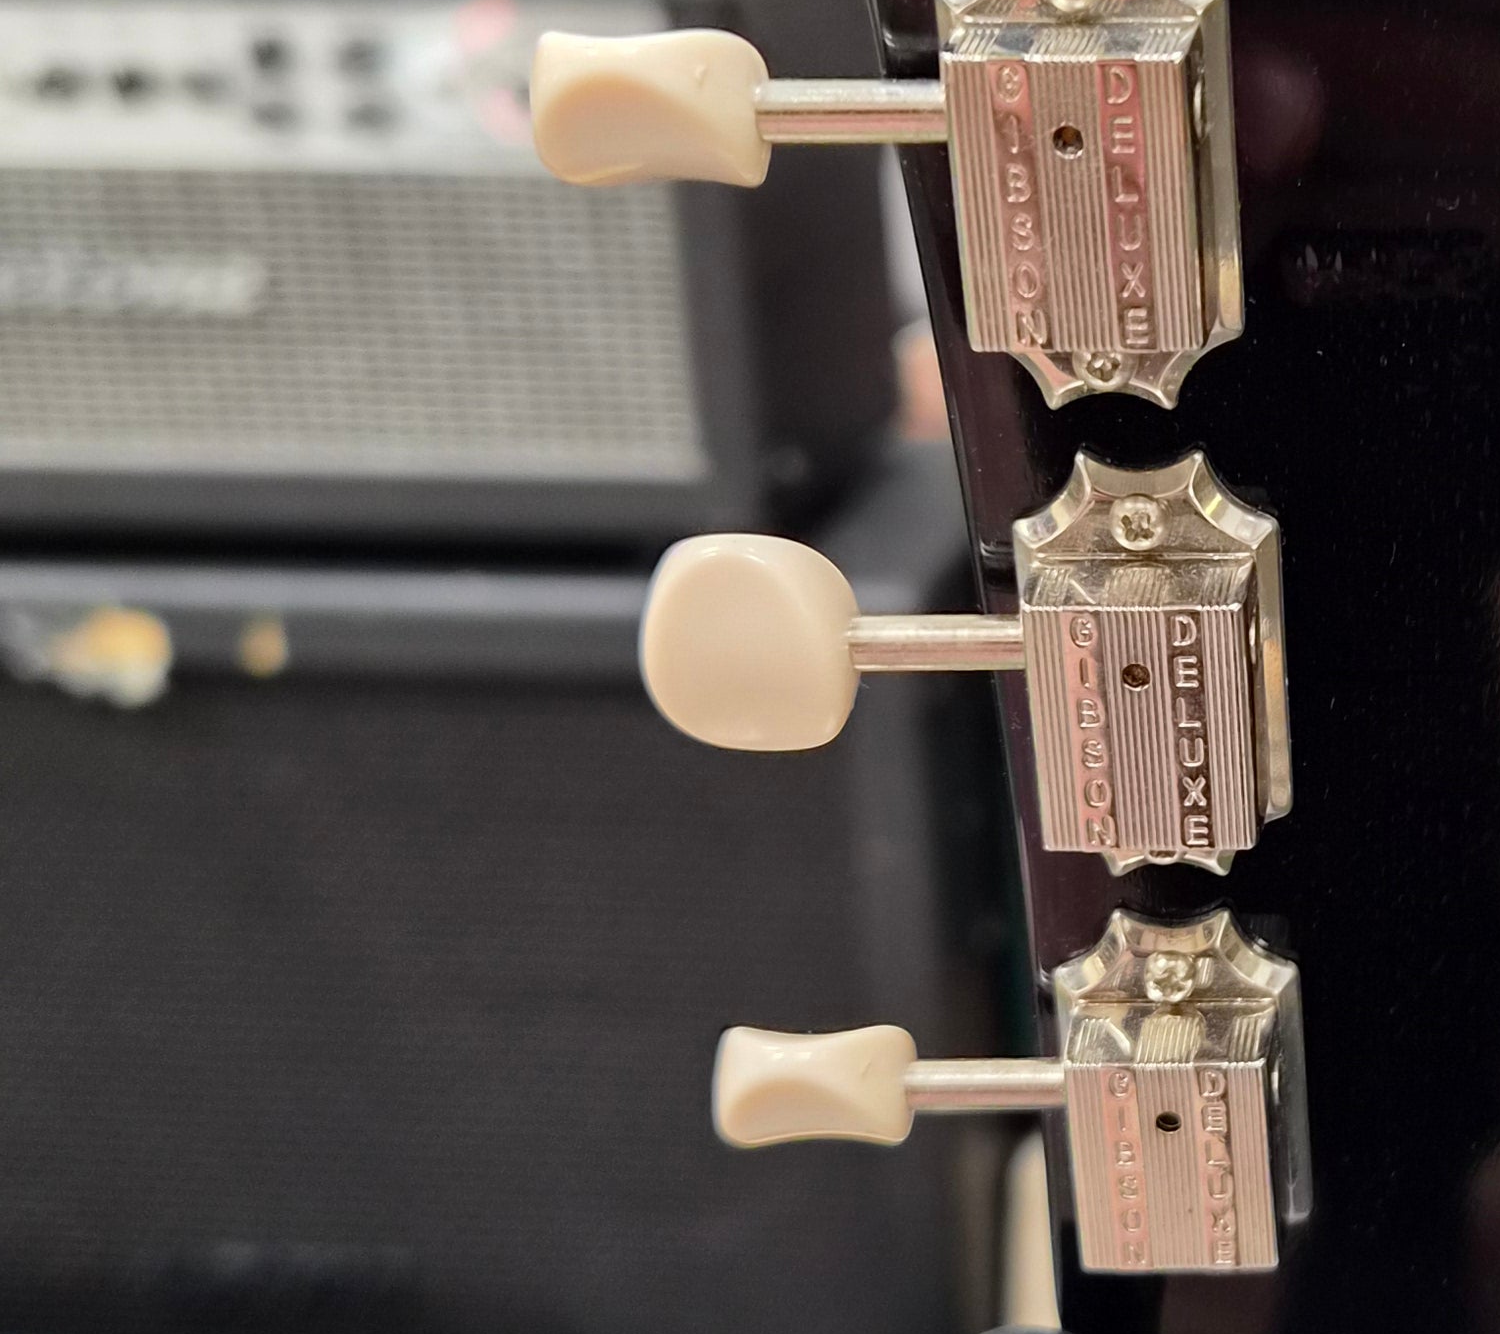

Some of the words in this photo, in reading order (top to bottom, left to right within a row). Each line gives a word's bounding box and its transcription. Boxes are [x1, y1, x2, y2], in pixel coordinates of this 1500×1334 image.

[998, 67, 1048, 347] GIBSON
[1105, 67, 1152, 346] DELUXE
[1069, 616, 1116, 848] GIBSON
[1170, 615, 1211, 847] DELUXE
